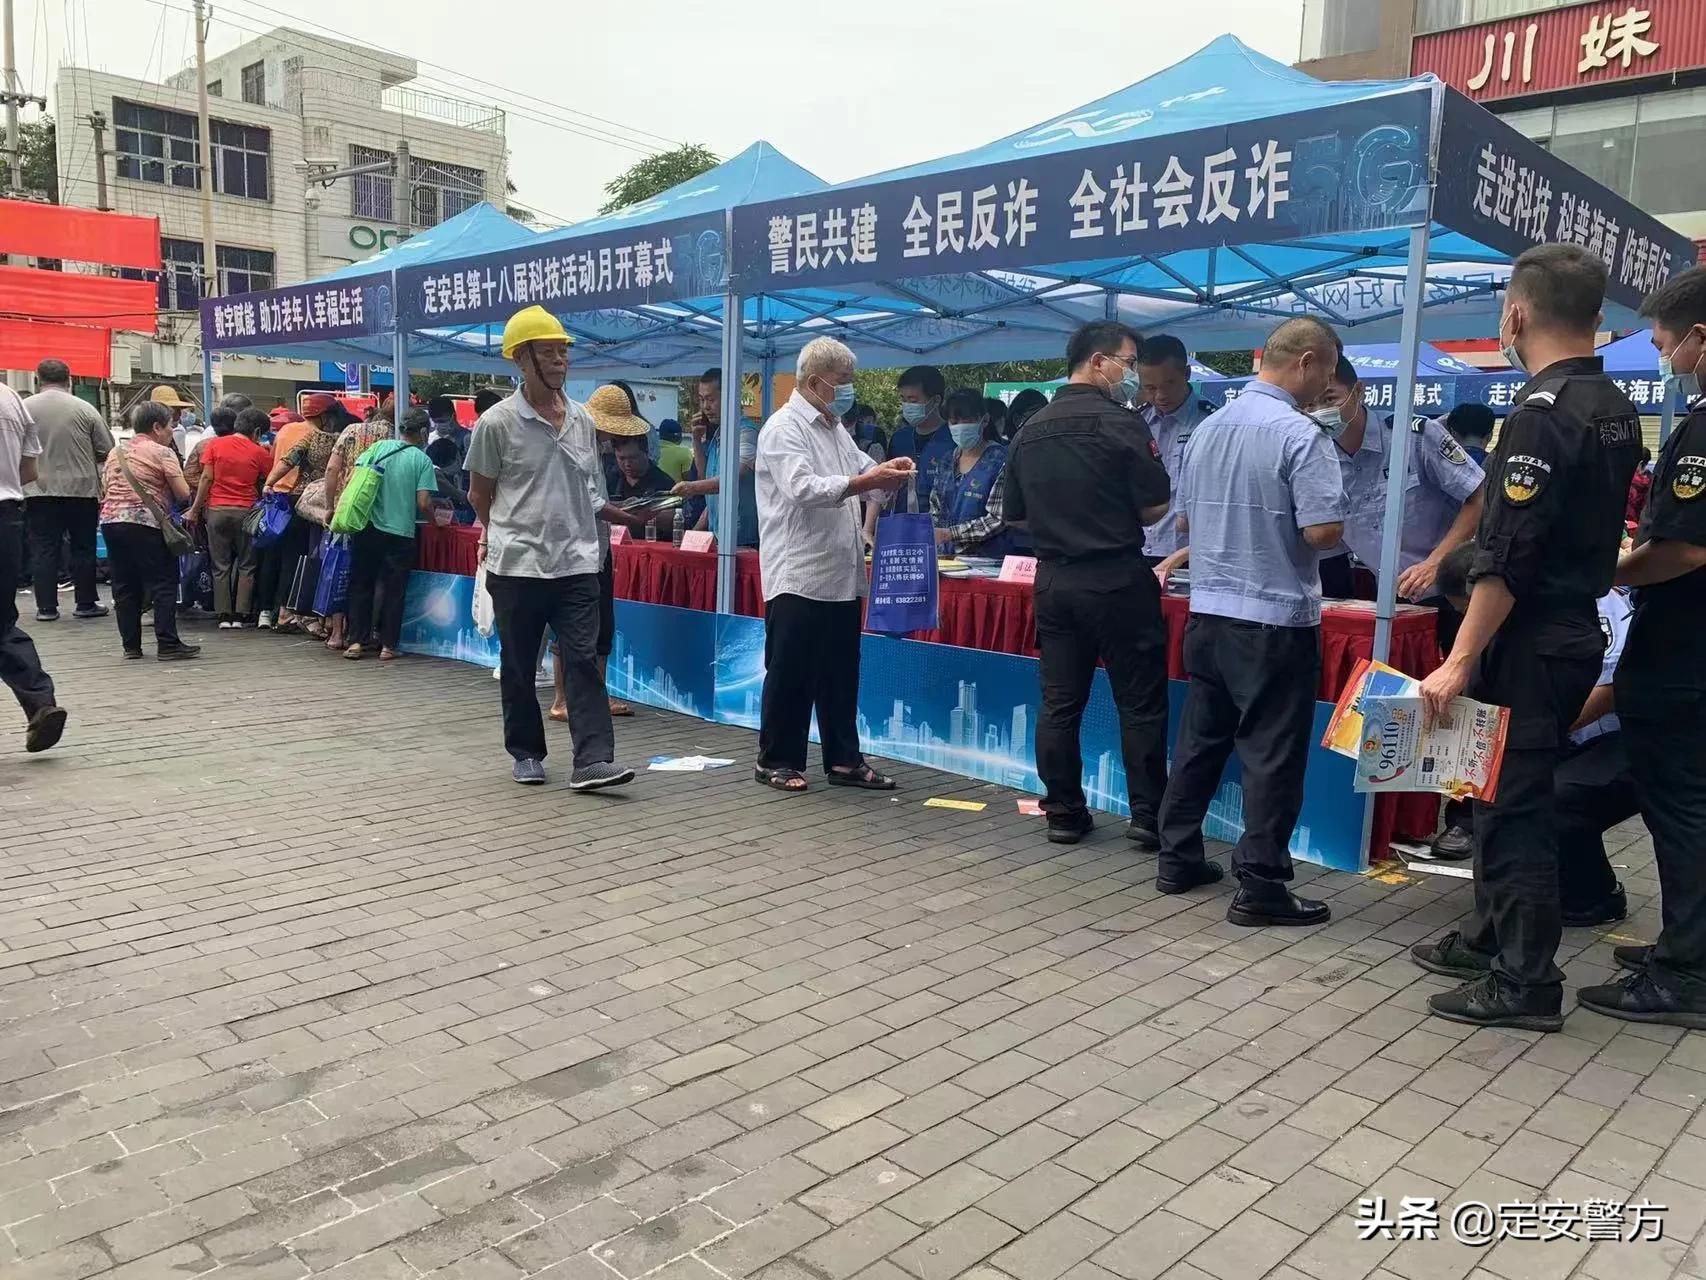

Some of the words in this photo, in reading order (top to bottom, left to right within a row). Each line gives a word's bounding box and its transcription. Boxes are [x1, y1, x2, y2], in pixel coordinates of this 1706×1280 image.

[1467, 7, 1660, 91] 川妹
[768, 202, 878, 274] 警民共建
[902, 178, 1039, 259] 全民反诈
[1069, 139, 1292, 240] 全社会反诈
[1473, 142, 1553, 244] 走进科技
[1556, 191, 1620, 277] 科普海南
[1619, 227, 1672, 294] 你我同行
[423, 236, 674, 315] 定安县第十八届科技活动月开幕式
[214, 301, 256, 339] 数字赋能
[260, 286, 363, 334] 助力老年人幸福生活
[1364, 383, 1443, 407] 动月幕式
[1513, 454, 1548, 468] SWAT
[1379, 721, 1401, 770] 96110
